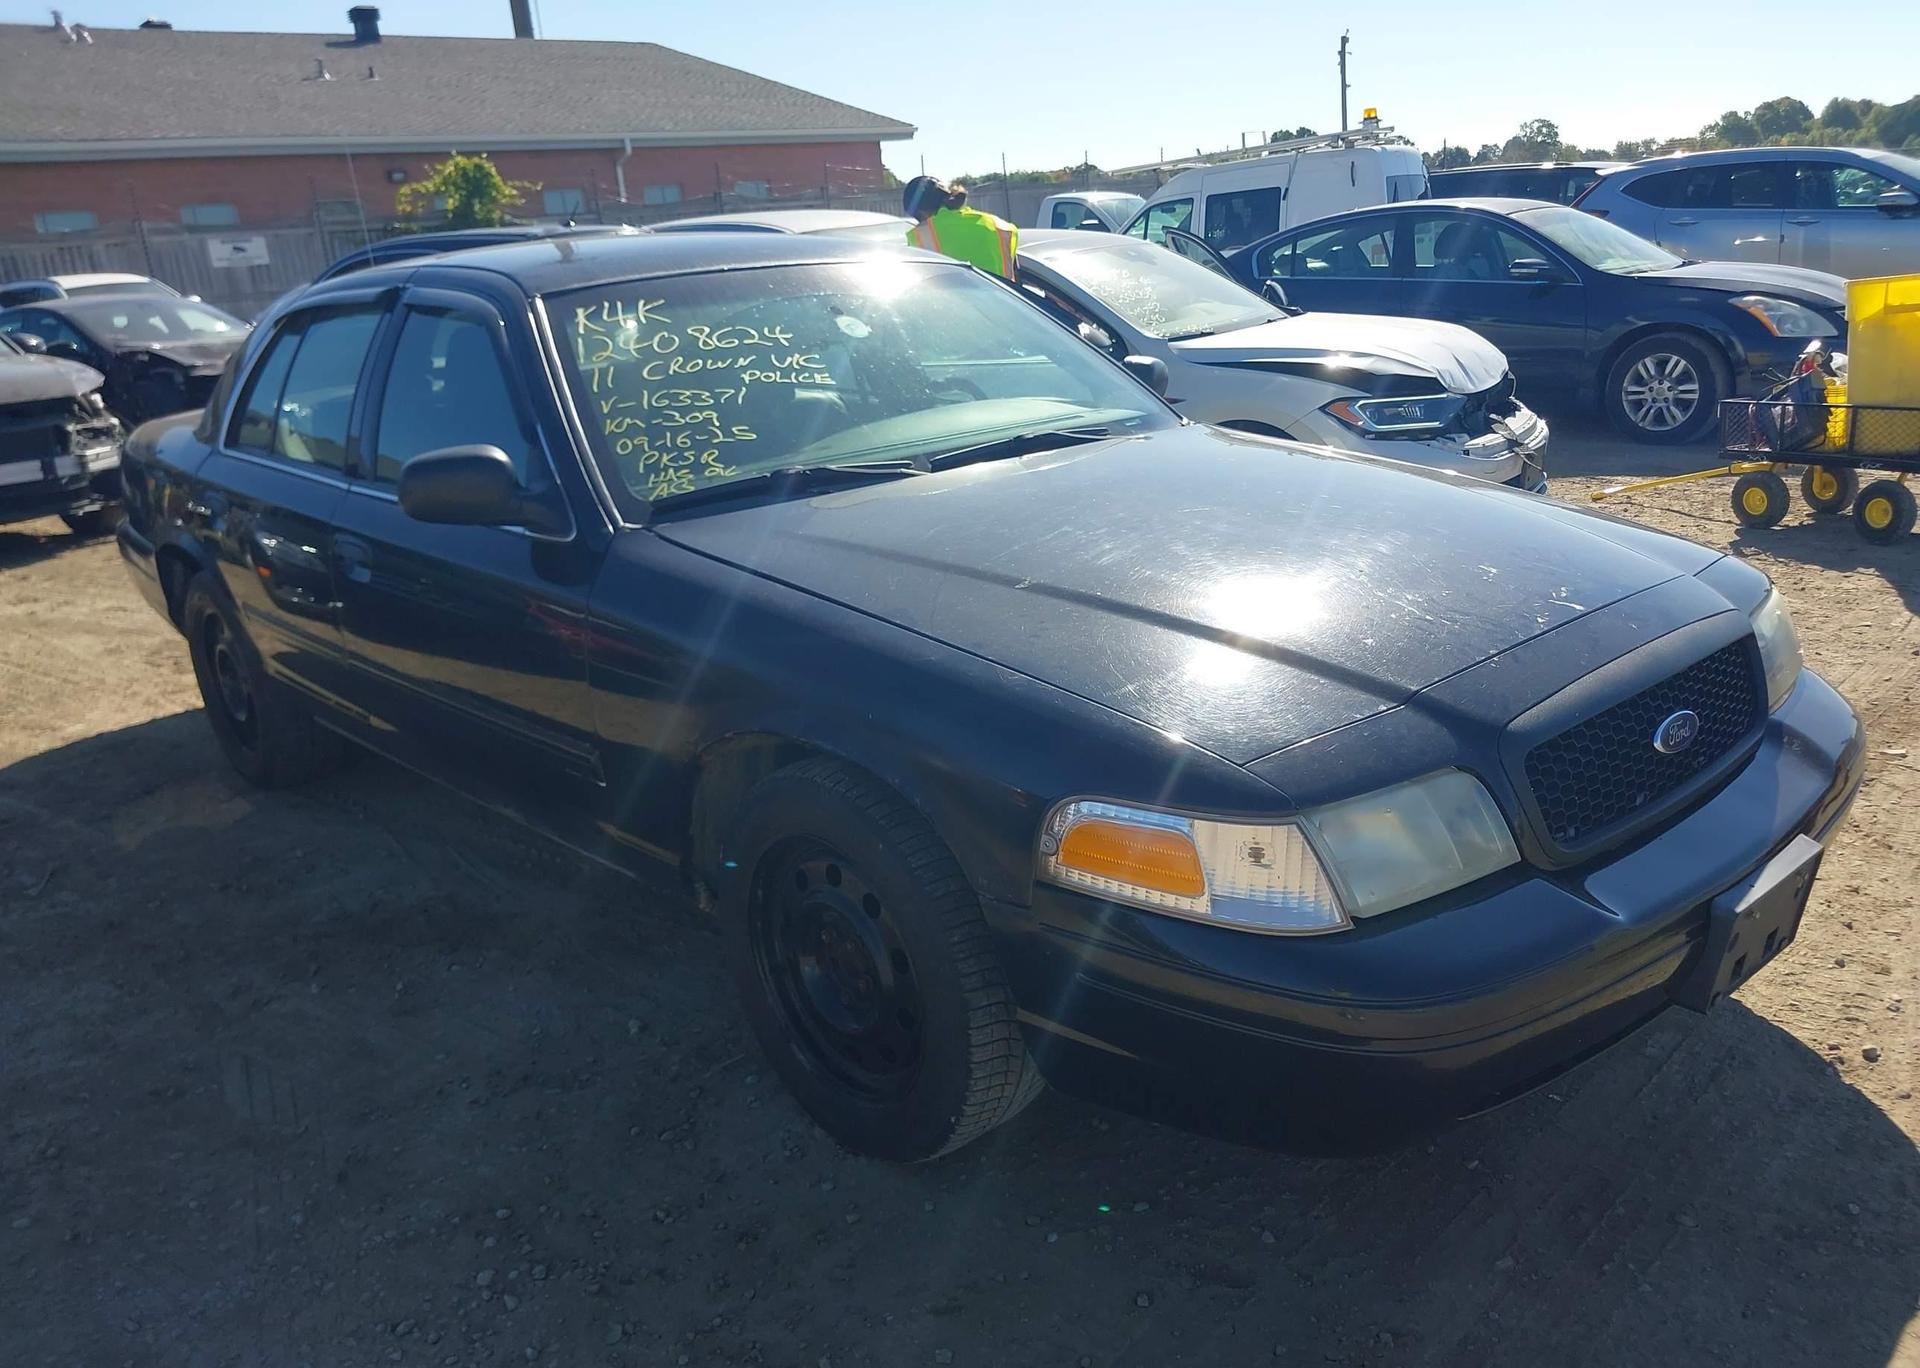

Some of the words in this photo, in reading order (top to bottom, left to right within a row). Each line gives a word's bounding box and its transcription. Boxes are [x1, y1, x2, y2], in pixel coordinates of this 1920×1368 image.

[576, 299, 671, 334] K4K
[642, 355, 757, 380] CROWN
[770, 353, 826, 369] VIC
[740, 370, 836, 385] POLICE
[1669, 719, 1690, 746] Ford
